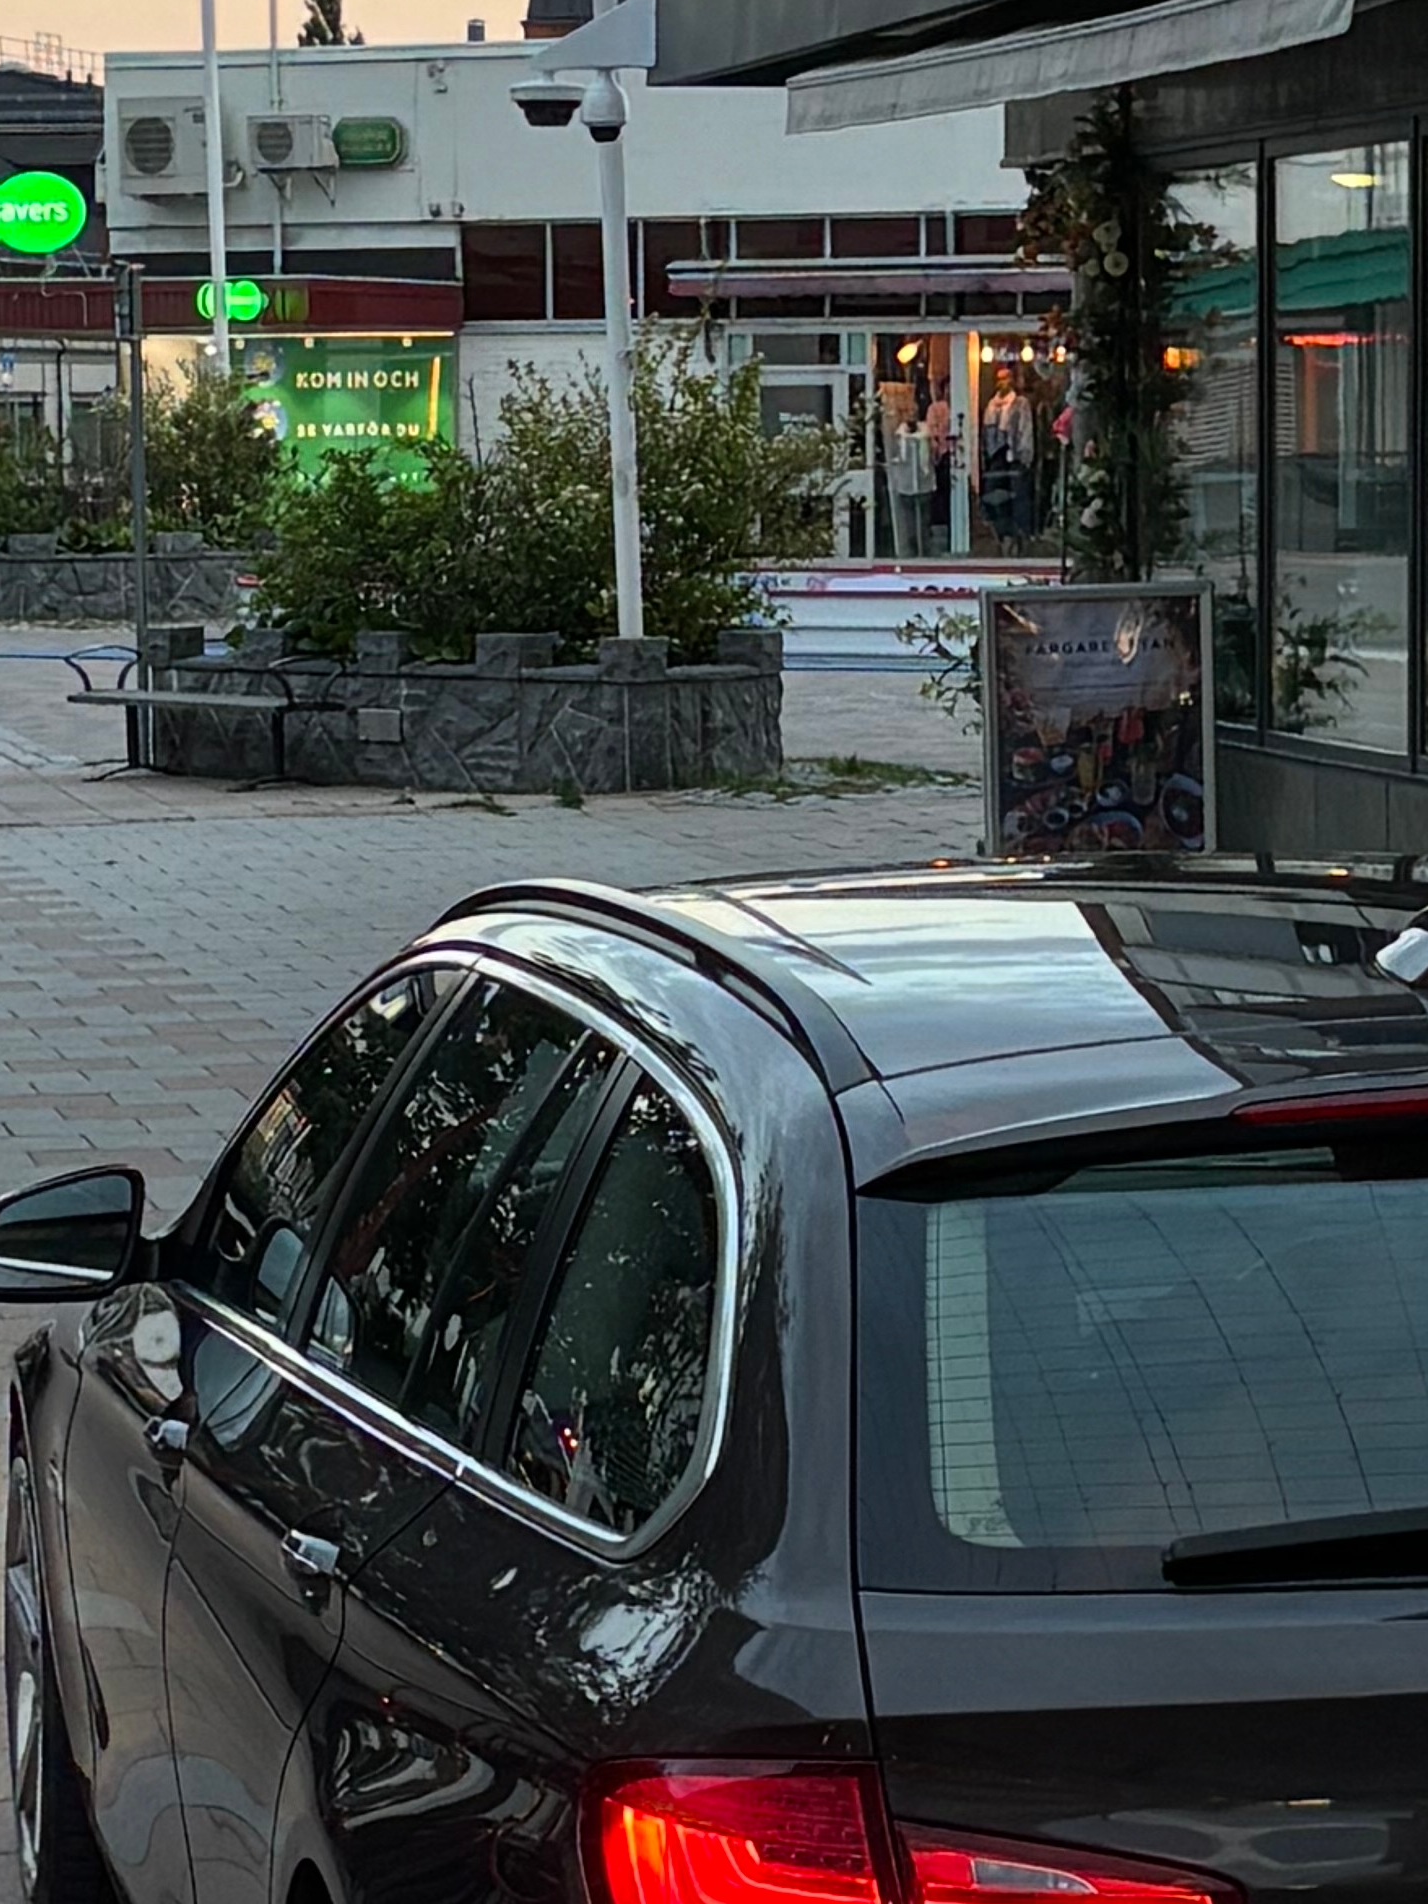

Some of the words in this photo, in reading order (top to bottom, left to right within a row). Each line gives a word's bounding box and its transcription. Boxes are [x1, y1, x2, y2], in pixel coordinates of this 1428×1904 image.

[296, 372, 342, 388] KOM
[347, 371, 369, 388] IN
[373, 370, 419, 388] OCH
[397, 423, 420, 437] DU
